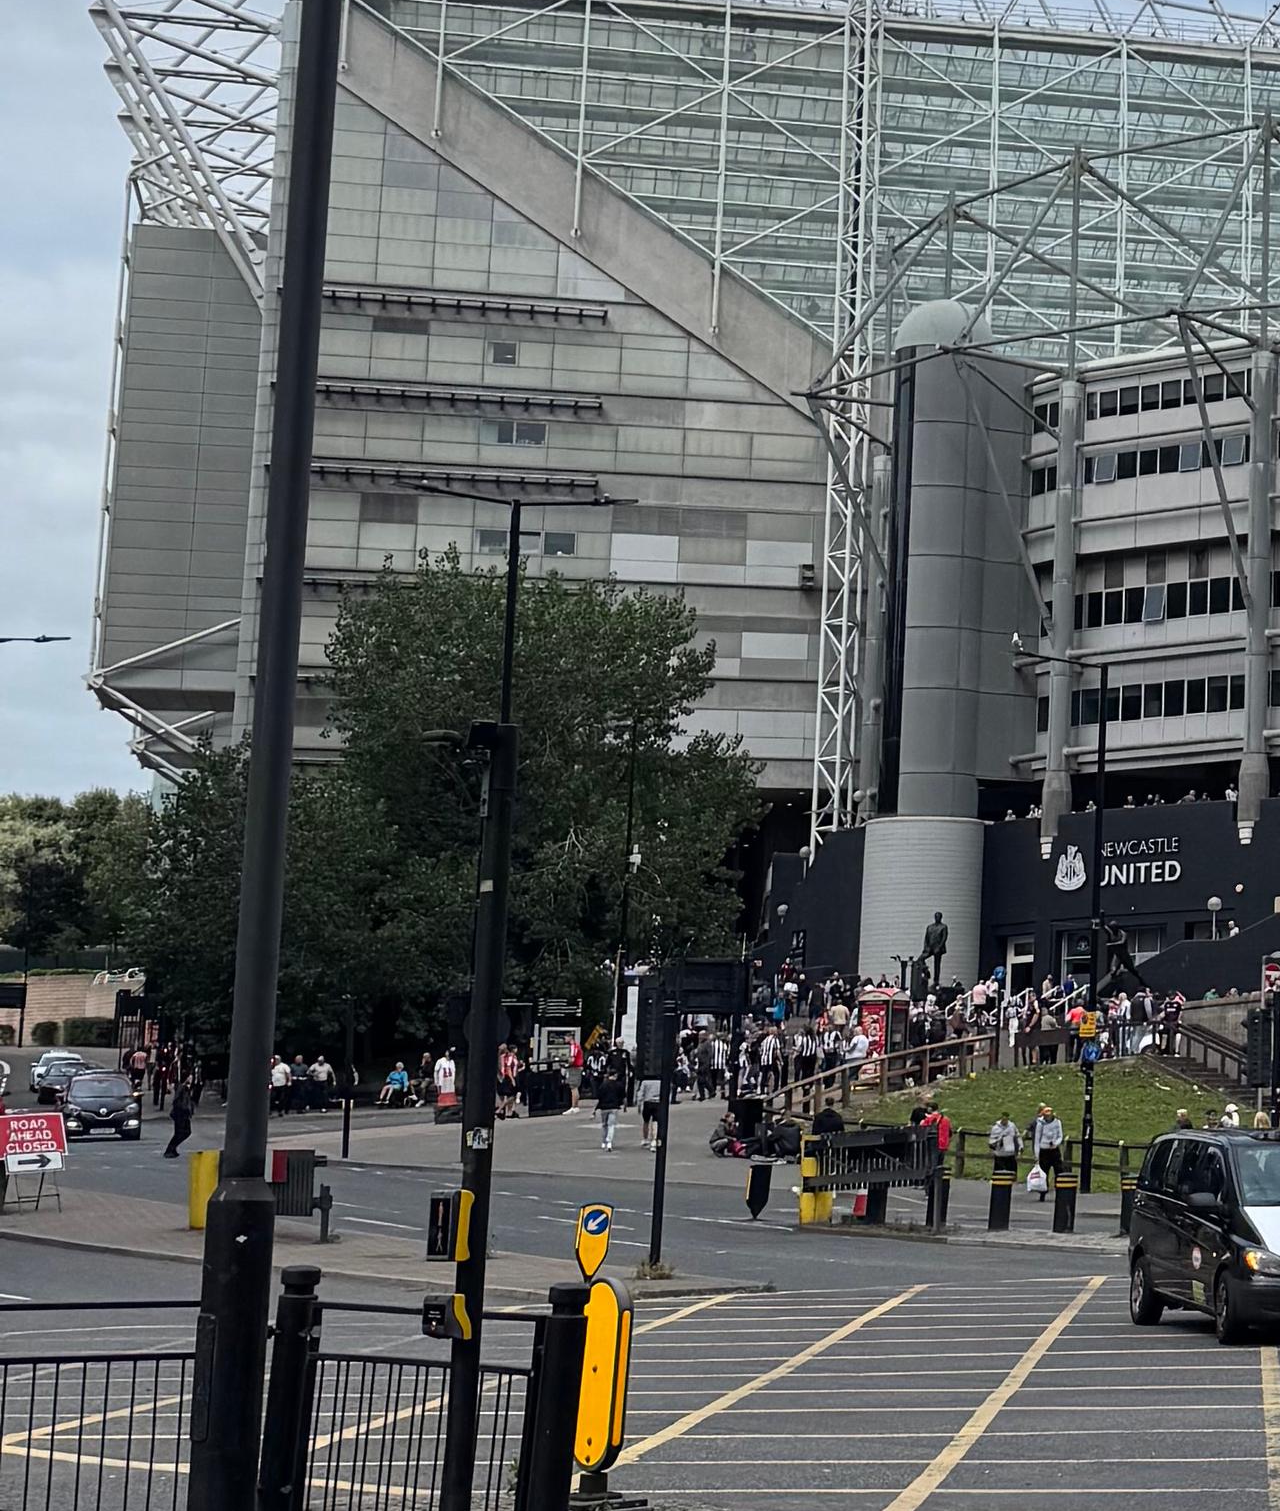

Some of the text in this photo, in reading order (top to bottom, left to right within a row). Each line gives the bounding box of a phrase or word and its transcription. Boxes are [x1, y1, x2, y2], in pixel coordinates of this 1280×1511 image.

[10, 1119, 48, 1130] ROAD
[9, 1130, 52, 1142] AHEAD
[6, 1141, 57, 1153] CLOSED
